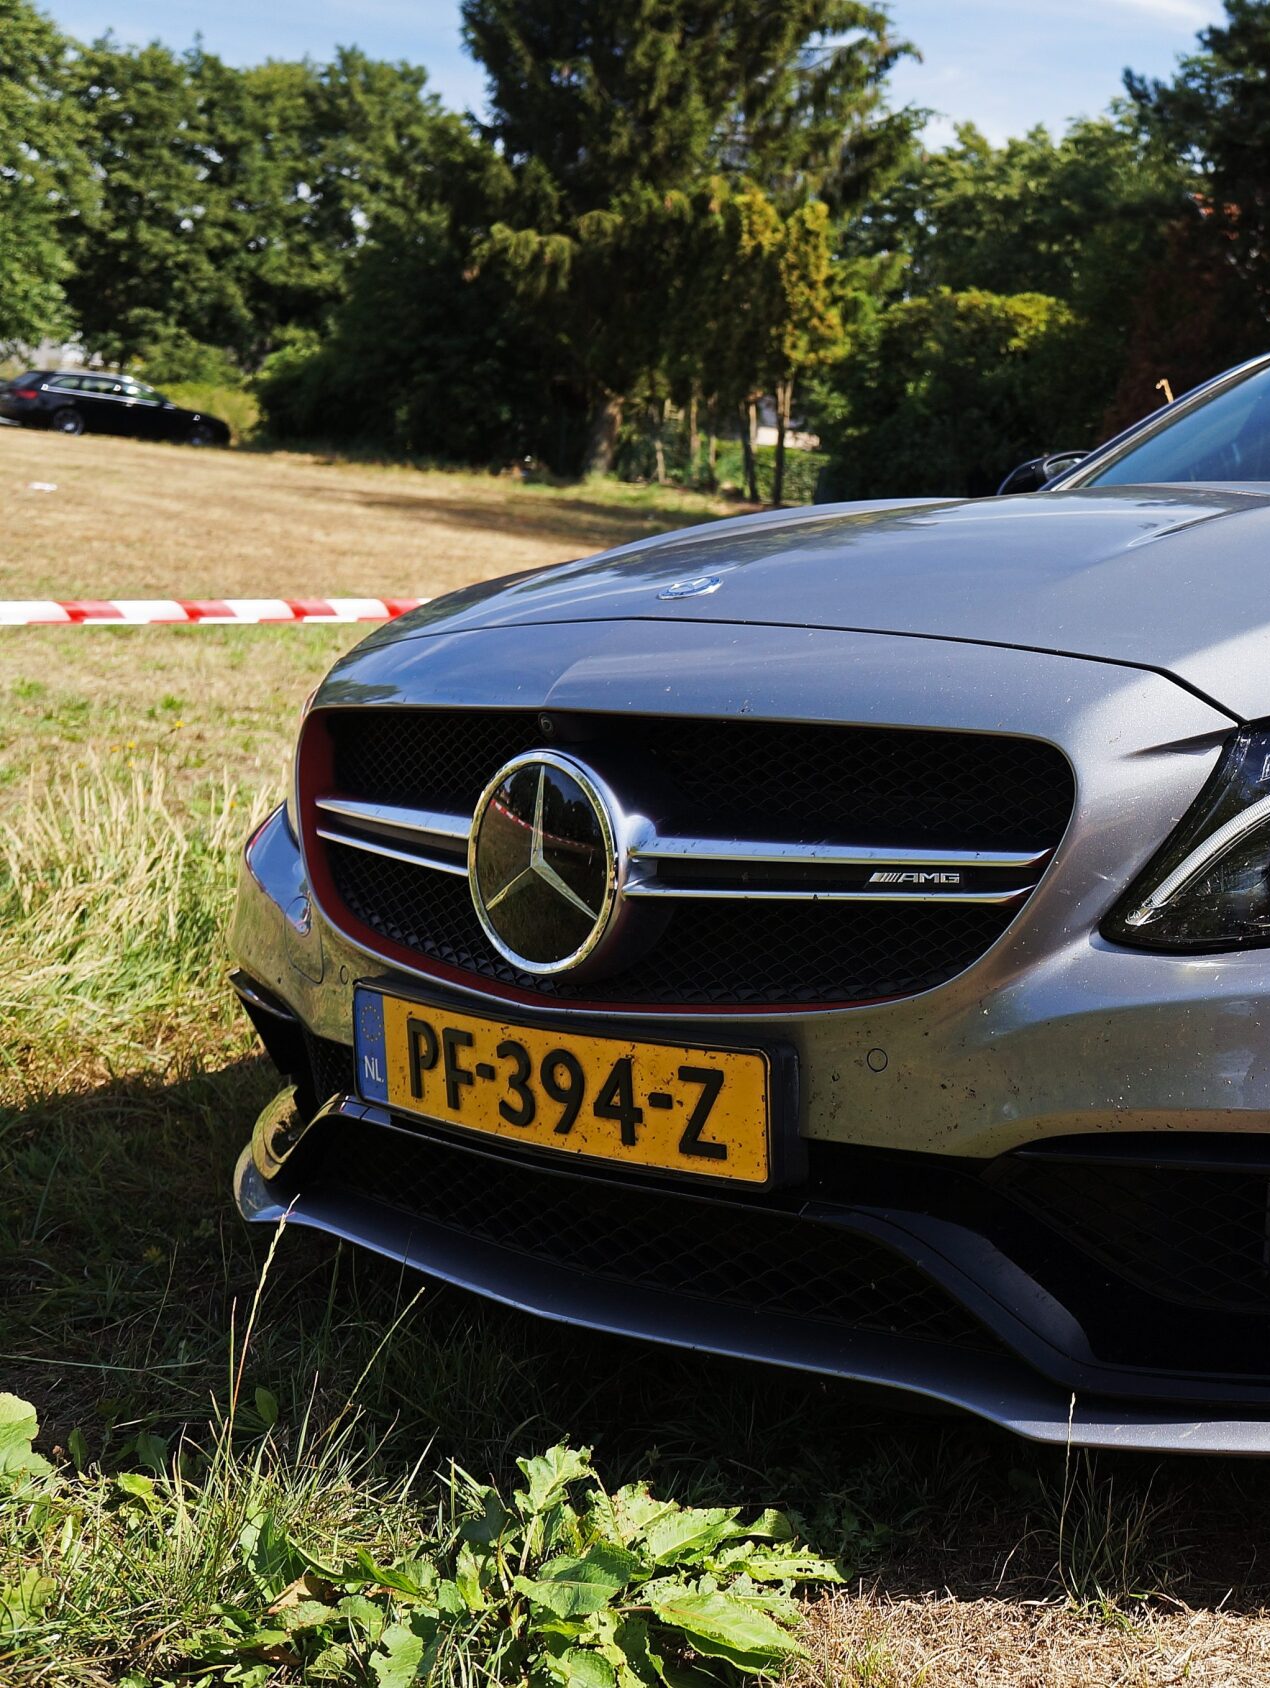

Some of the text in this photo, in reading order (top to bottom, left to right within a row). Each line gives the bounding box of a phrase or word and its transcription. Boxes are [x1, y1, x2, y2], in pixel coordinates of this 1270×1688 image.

[897, 872, 960, 884] AMG
[363, 1055, 384, 1083] NL
[406, 1017, 728, 1161] PF-394-Z
